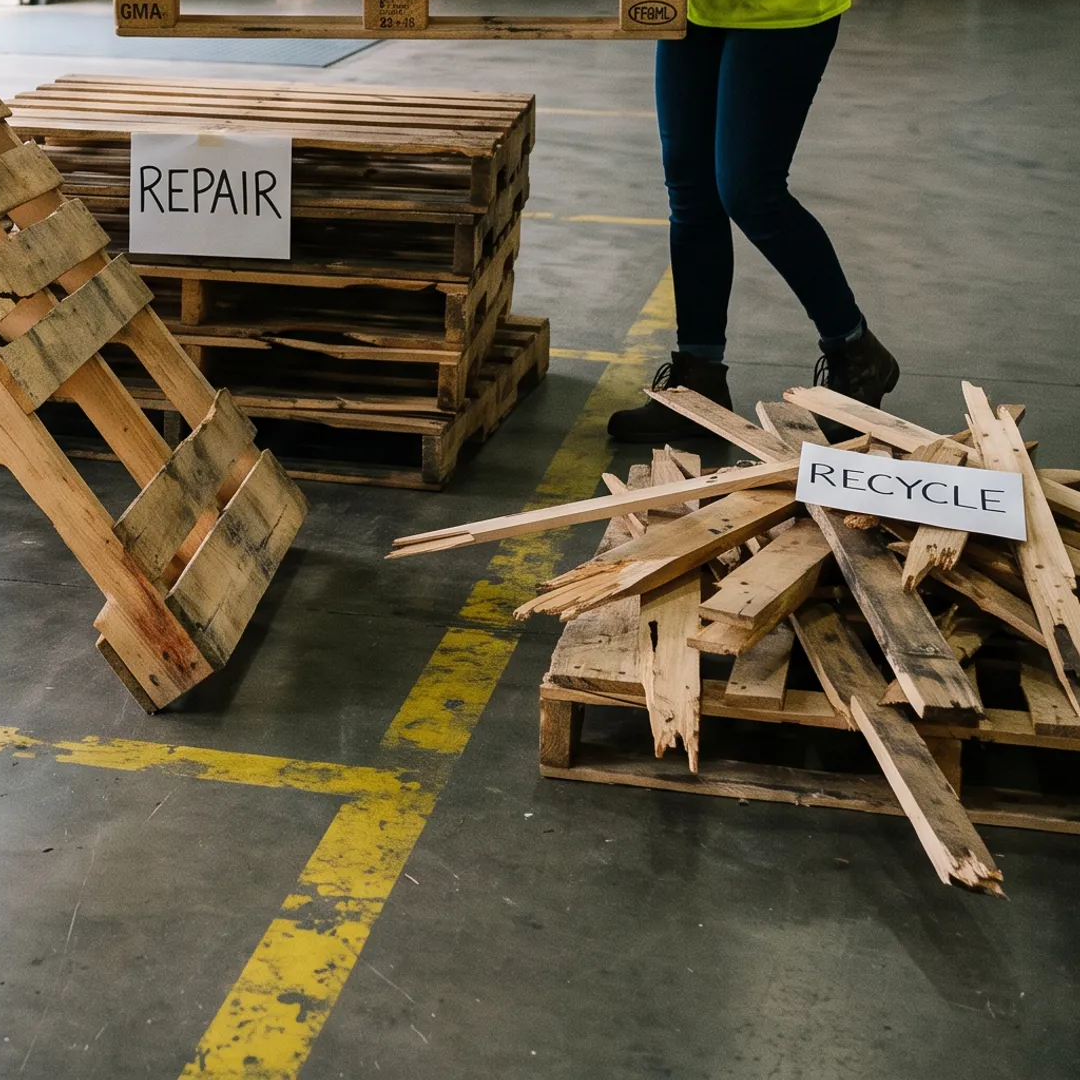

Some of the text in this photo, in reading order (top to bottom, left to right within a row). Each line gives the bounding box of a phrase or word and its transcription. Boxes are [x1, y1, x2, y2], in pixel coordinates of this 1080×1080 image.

[120, 3, 162, 20] GMA
[139, 165, 282, 220] REPAIR
[809, 462, 1007, 514] RECYCLE
